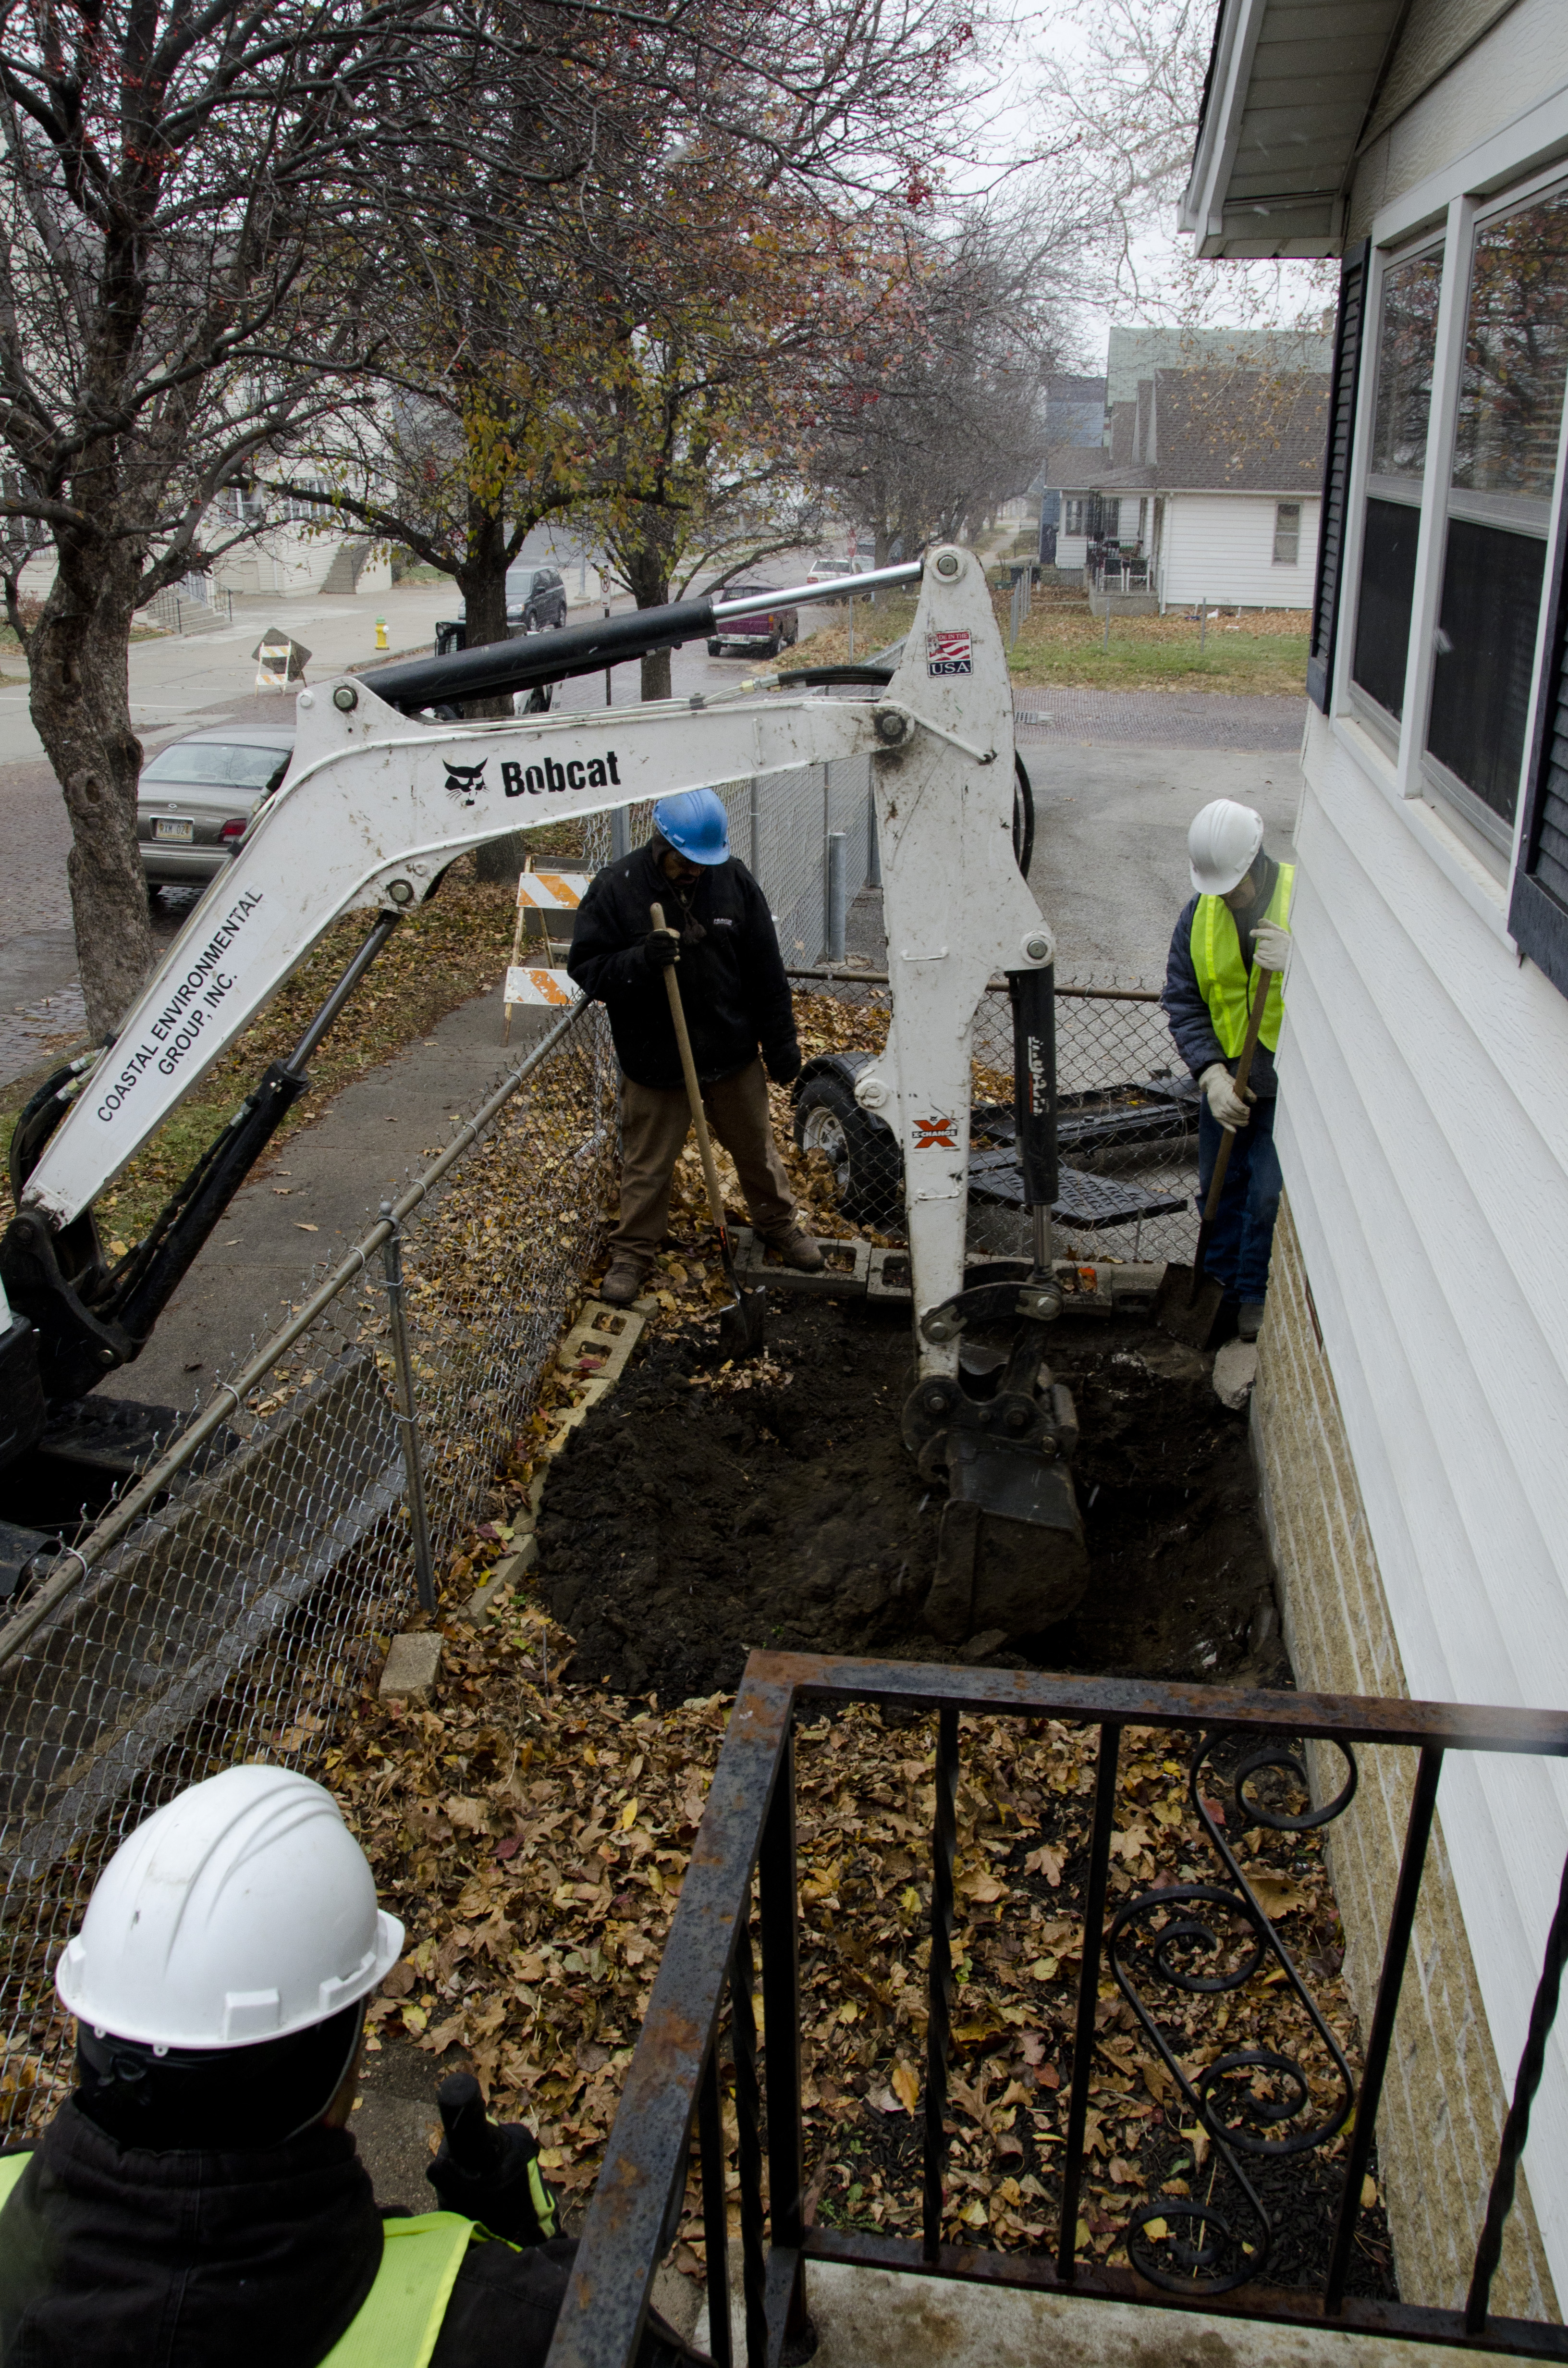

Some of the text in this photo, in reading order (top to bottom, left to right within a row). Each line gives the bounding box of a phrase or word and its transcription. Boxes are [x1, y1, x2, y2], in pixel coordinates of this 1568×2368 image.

[931, 662, 970, 674] USA
[501, 751, 621, 798] Bobcat
[98, 891, 263, 1122] COASTAL ENVIRONMENTAL
[158, 973, 238, 1075] GROUP, INC.
